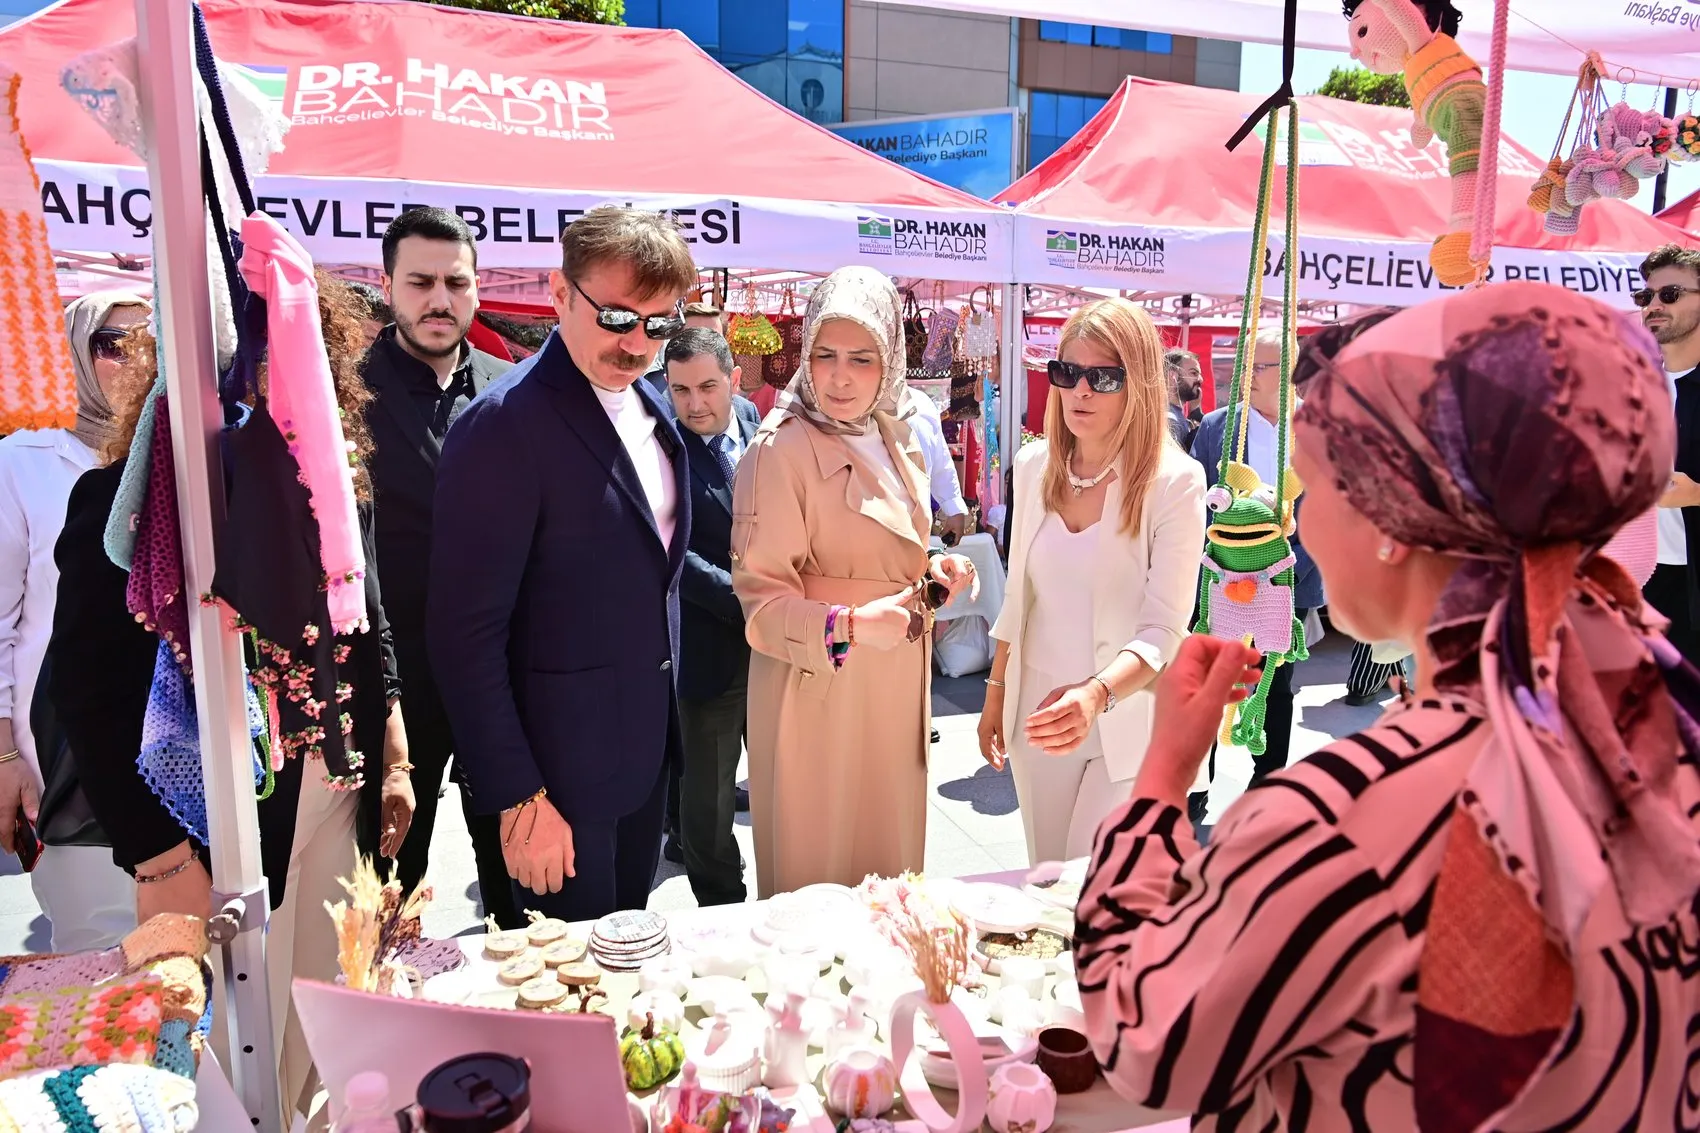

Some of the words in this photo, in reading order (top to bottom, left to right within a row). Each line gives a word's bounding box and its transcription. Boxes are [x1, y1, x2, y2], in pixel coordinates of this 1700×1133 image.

[298, 62, 393, 90] DR.
[407, 58, 606, 104] HAKAN
[292, 82, 612, 130] BAHADIR
[291, 105, 426, 126] Bahçelievler
[432, 110, 528, 135] Belediye
[533, 126, 615, 141] Başkanı
[851, 136, 897, 152] AKAN
[901, 128, 987, 150] BAHADIR
[941, 149, 987, 161] Başkanı
[894, 219, 922, 235] DR.
[926, 221, 986, 239] HAKAN
[894, 233, 987, 254] BAHADIR
[1079, 233, 1105, 249] DR.
[1108, 235, 1164, 252] HAKAN
[934, 251, 961, 261] Belediye
[962, 252, 987, 262] Başkanı
[1077, 248, 1165, 268] BAHADIR
[1113, 265, 1140, 274] Belediye
[1141, 267, 1165, 275] Başkanı
